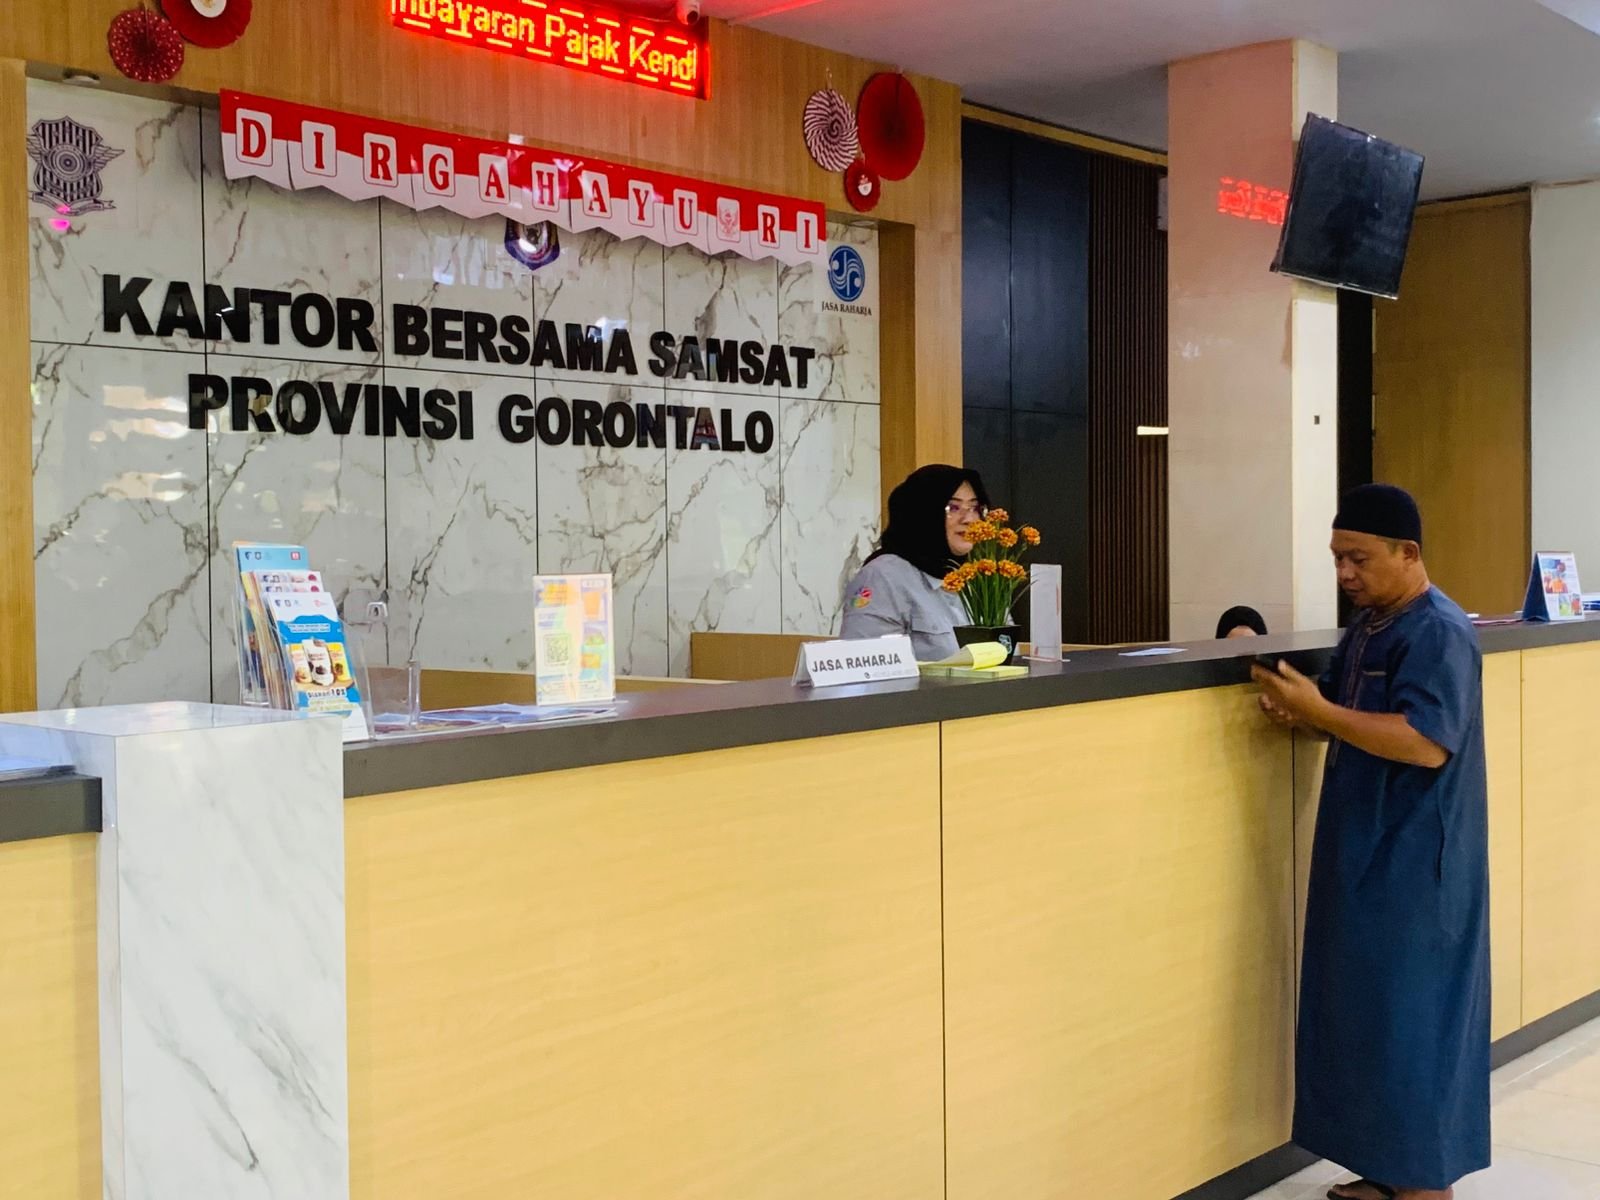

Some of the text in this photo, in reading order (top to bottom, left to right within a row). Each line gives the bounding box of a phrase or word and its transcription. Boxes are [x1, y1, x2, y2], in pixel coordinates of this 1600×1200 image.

[546, 14, 620, 66] Pajak
[241, 117, 811, 249] DIRGAHAYU RI
[103, 274, 815, 388] KANTOR BERSAMA SAMSAT
[821, 300, 873, 316] JASA RAHARJA
[188, 373, 774, 454] PROVINSI GORONTALO
[812, 653, 902, 673] JASA RAHARJA
